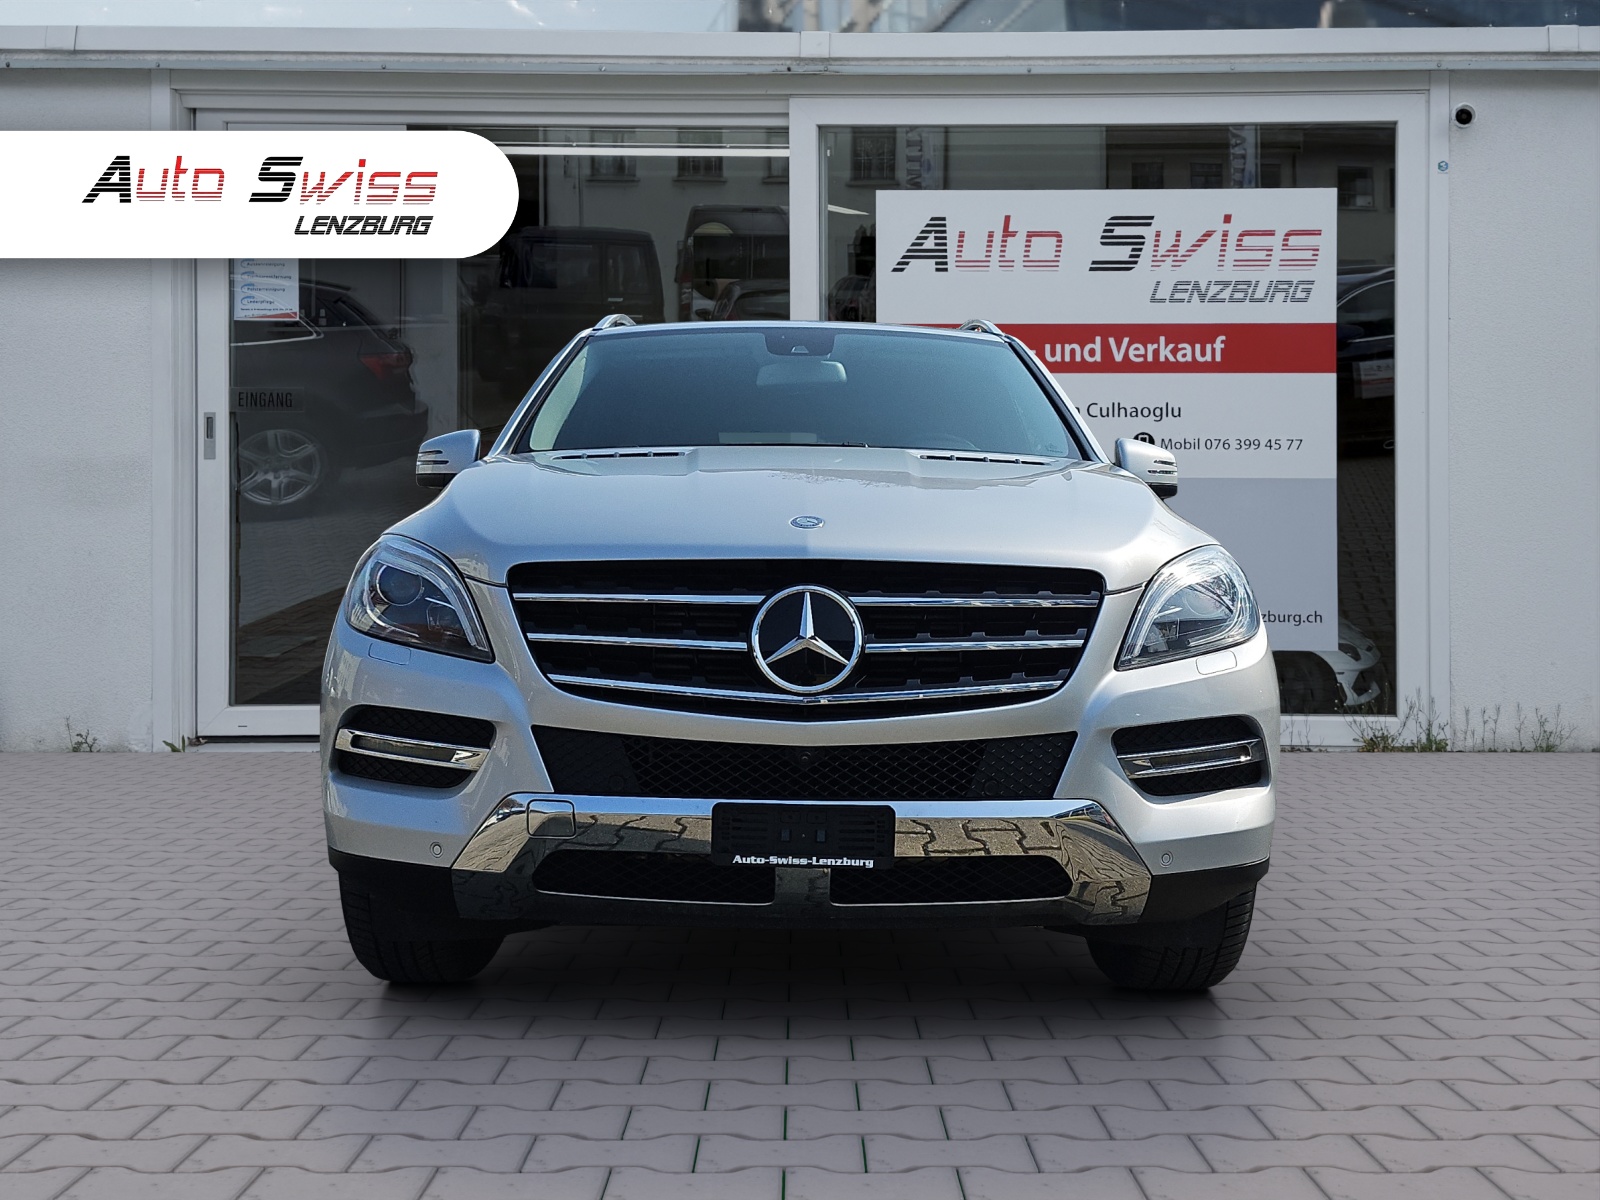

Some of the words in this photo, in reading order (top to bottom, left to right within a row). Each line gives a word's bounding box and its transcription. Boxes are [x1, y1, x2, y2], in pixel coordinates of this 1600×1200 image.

[891, 215, 1063, 273] Auto
[1089, 214, 1322, 272] Swiss
[1150, 280, 1315, 304] LENZBURG
[1044, 336, 1102, 363] und
[1108, 335, 1227, 363] Verkauf
[238, 391, 293, 408] EINGANG
[1086, 402, 1182, 422] Culhaoglu
[1160, 438, 1201, 451] Mobil
[1204, 438, 1231, 451] 076
[1235, 438, 1261, 451] 399
[1264, 438, 1282, 451] 45
[1286, 438, 1304, 451] 77
[732, 854, 875, 869] Auto-Swiss-Lenzburg
